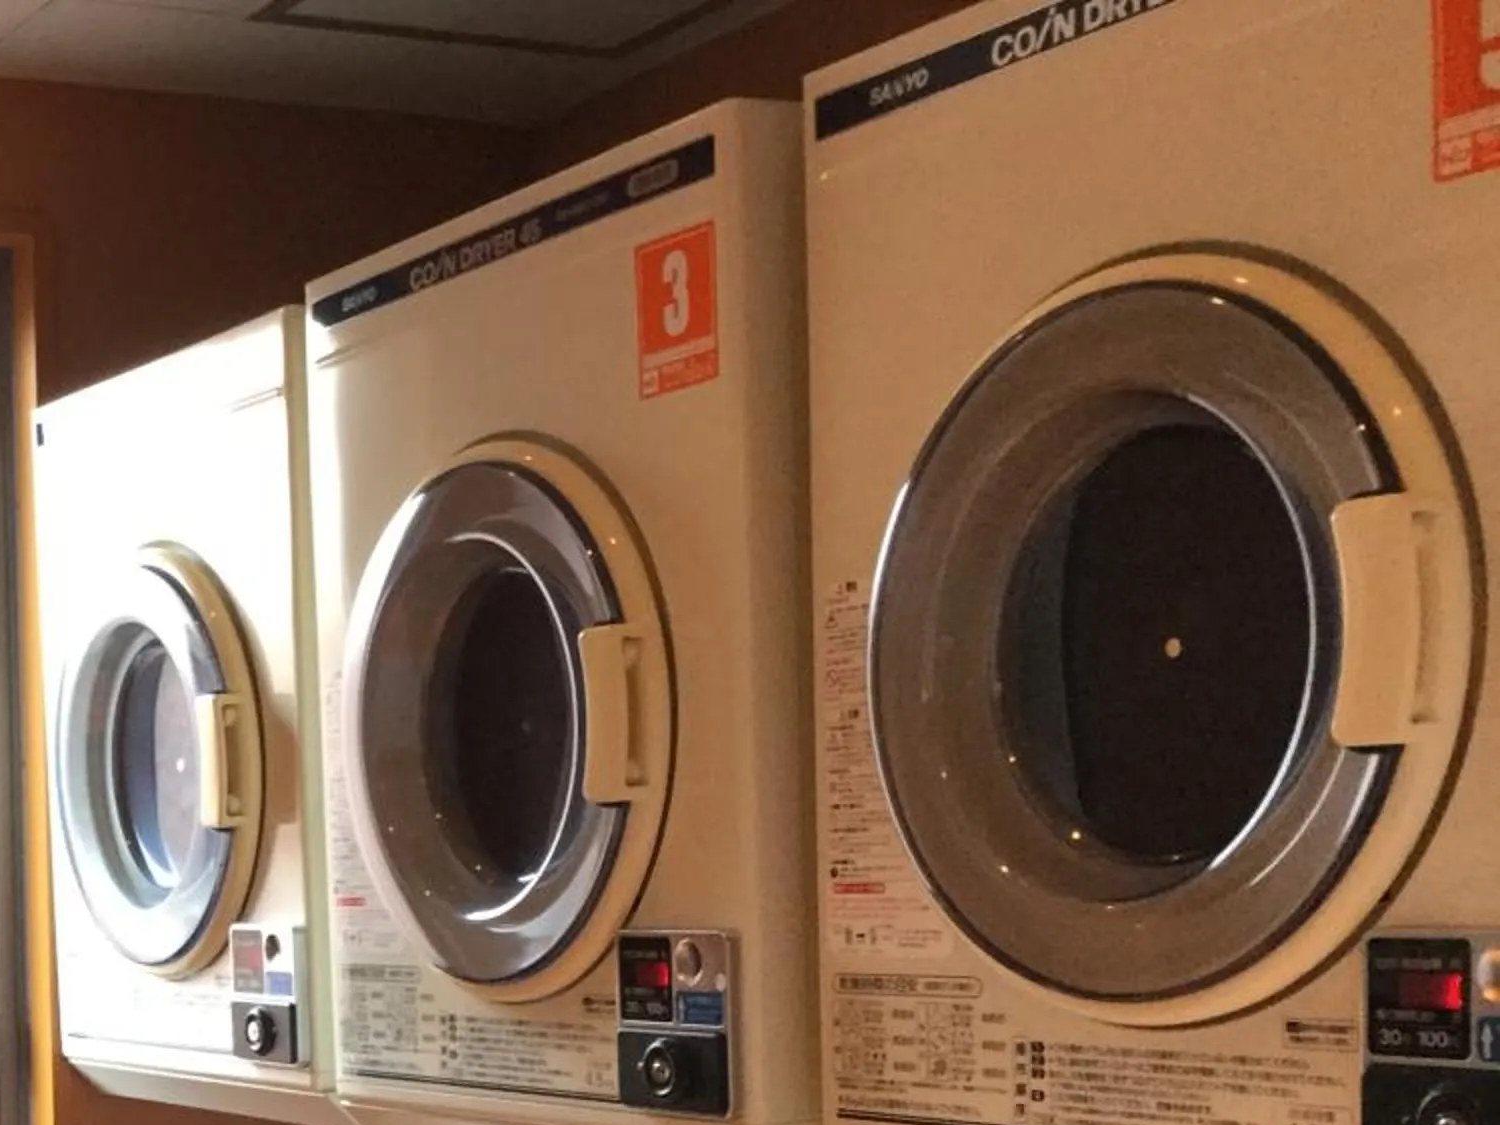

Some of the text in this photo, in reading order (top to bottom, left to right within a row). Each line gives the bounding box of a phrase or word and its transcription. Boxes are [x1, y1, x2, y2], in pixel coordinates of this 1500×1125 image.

[869, 66, 929, 107] SANYO
[460, 228, 516, 269] DRYER
[661, 248, 690, 338] 3
